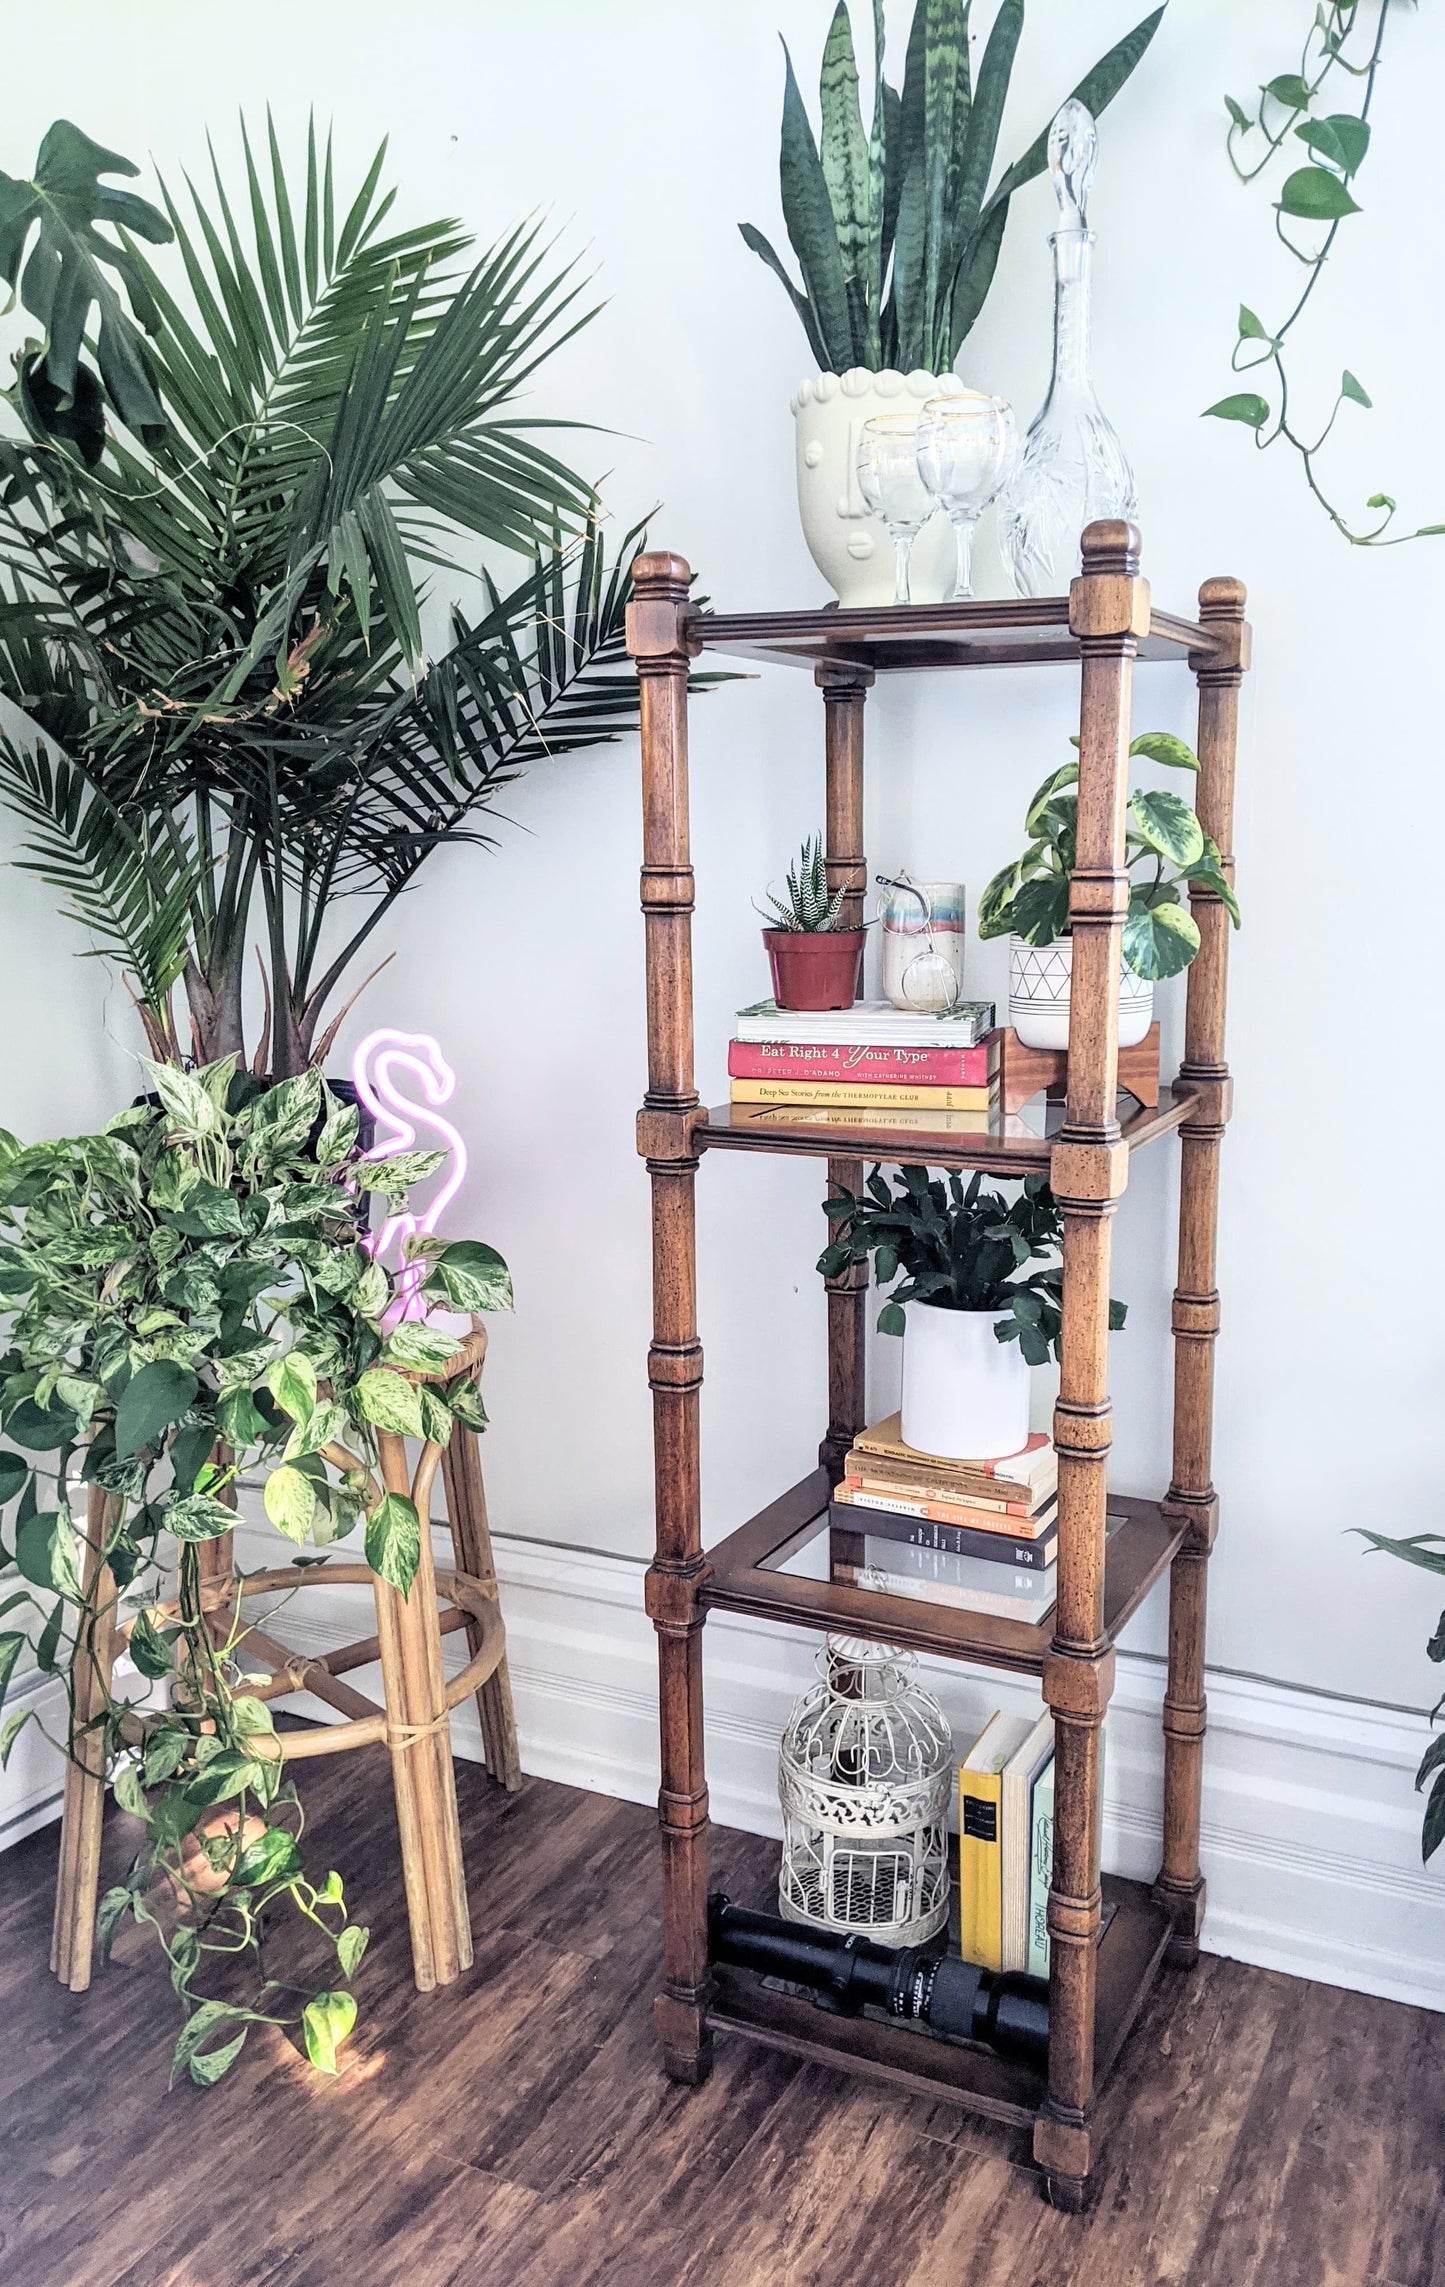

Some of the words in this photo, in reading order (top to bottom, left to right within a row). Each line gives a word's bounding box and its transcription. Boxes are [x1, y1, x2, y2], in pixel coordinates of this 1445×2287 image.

[760, 1044, 786, 1057] Eat
[789, 1045, 828, 1060] Right
[831, 1048, 840, 1059] 4
[842, 1046, 890, 1069] Your
[893, 1048, 928, 1064] Type
[803, 1069, 841, 1078] D'ADAMO
[873, 1072, 908, 1080] CATHERINE
[759, 1087, 778, 1098] Deep
[791, 1088, 813, 1097] Stories
[812, 1090, 831, 1100] from
[830, 1090, 841, 1098] the
[843, 1092, 898, 1101] THERMOPYLAE
[899, 1094, 919, 1102] CLUB
[946, 1091, 954, 1108] JUPP
[1034, 1902, 1047, 1961] THOREAU
